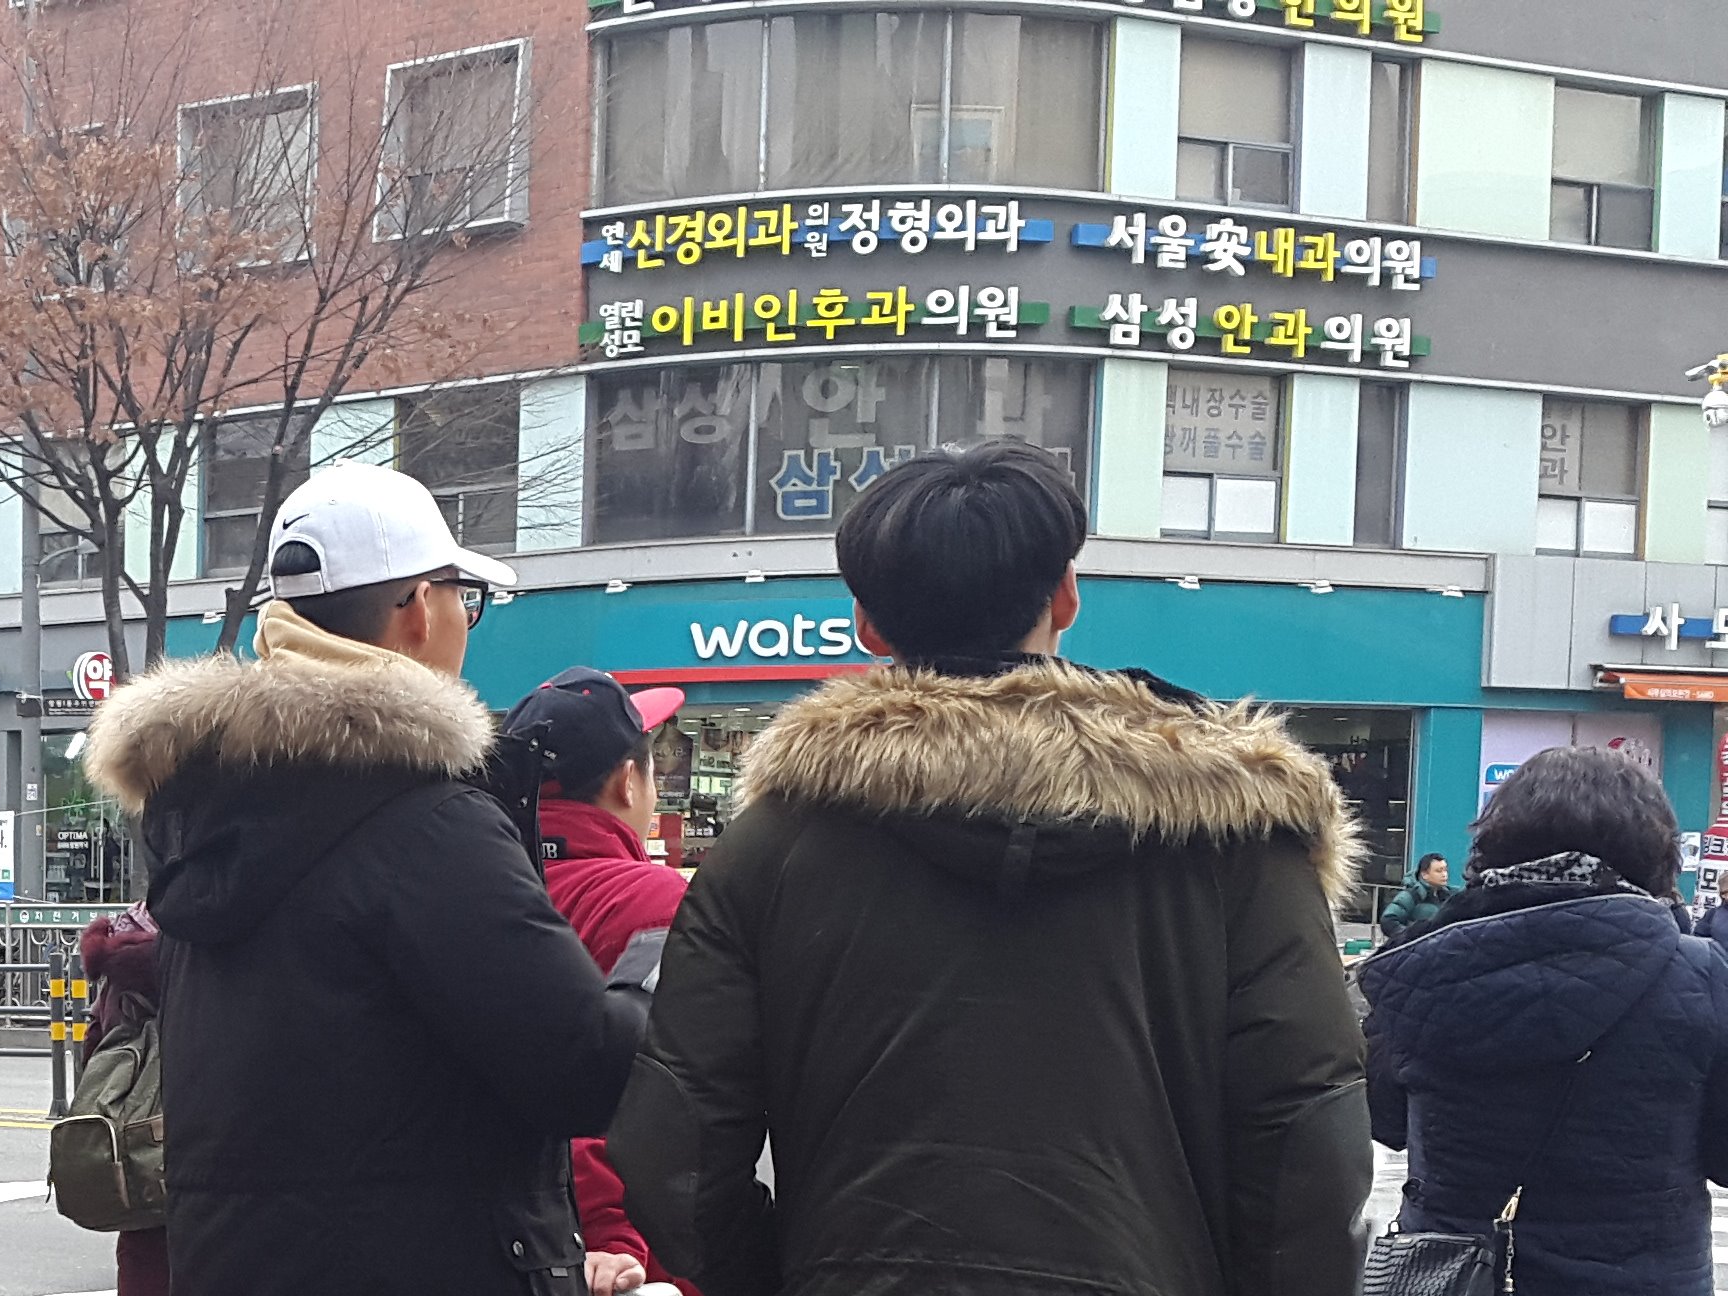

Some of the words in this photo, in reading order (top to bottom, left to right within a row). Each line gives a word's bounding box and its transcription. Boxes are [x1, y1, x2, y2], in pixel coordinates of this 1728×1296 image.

[599, 221, 625, 273] 연세
[627, 203, 799, 269] 신경외과
[804, 202, 829, 258] 의원
[838, 199, 1026, 254] 정형외과
[599, 299, 644, 330] 열린
[1098, 293, 1198, 350] 삼성
[600, 330, 645, 358] 성모
[690, 613, 872, 659] wats
[86, 658, 113, 698] 약
